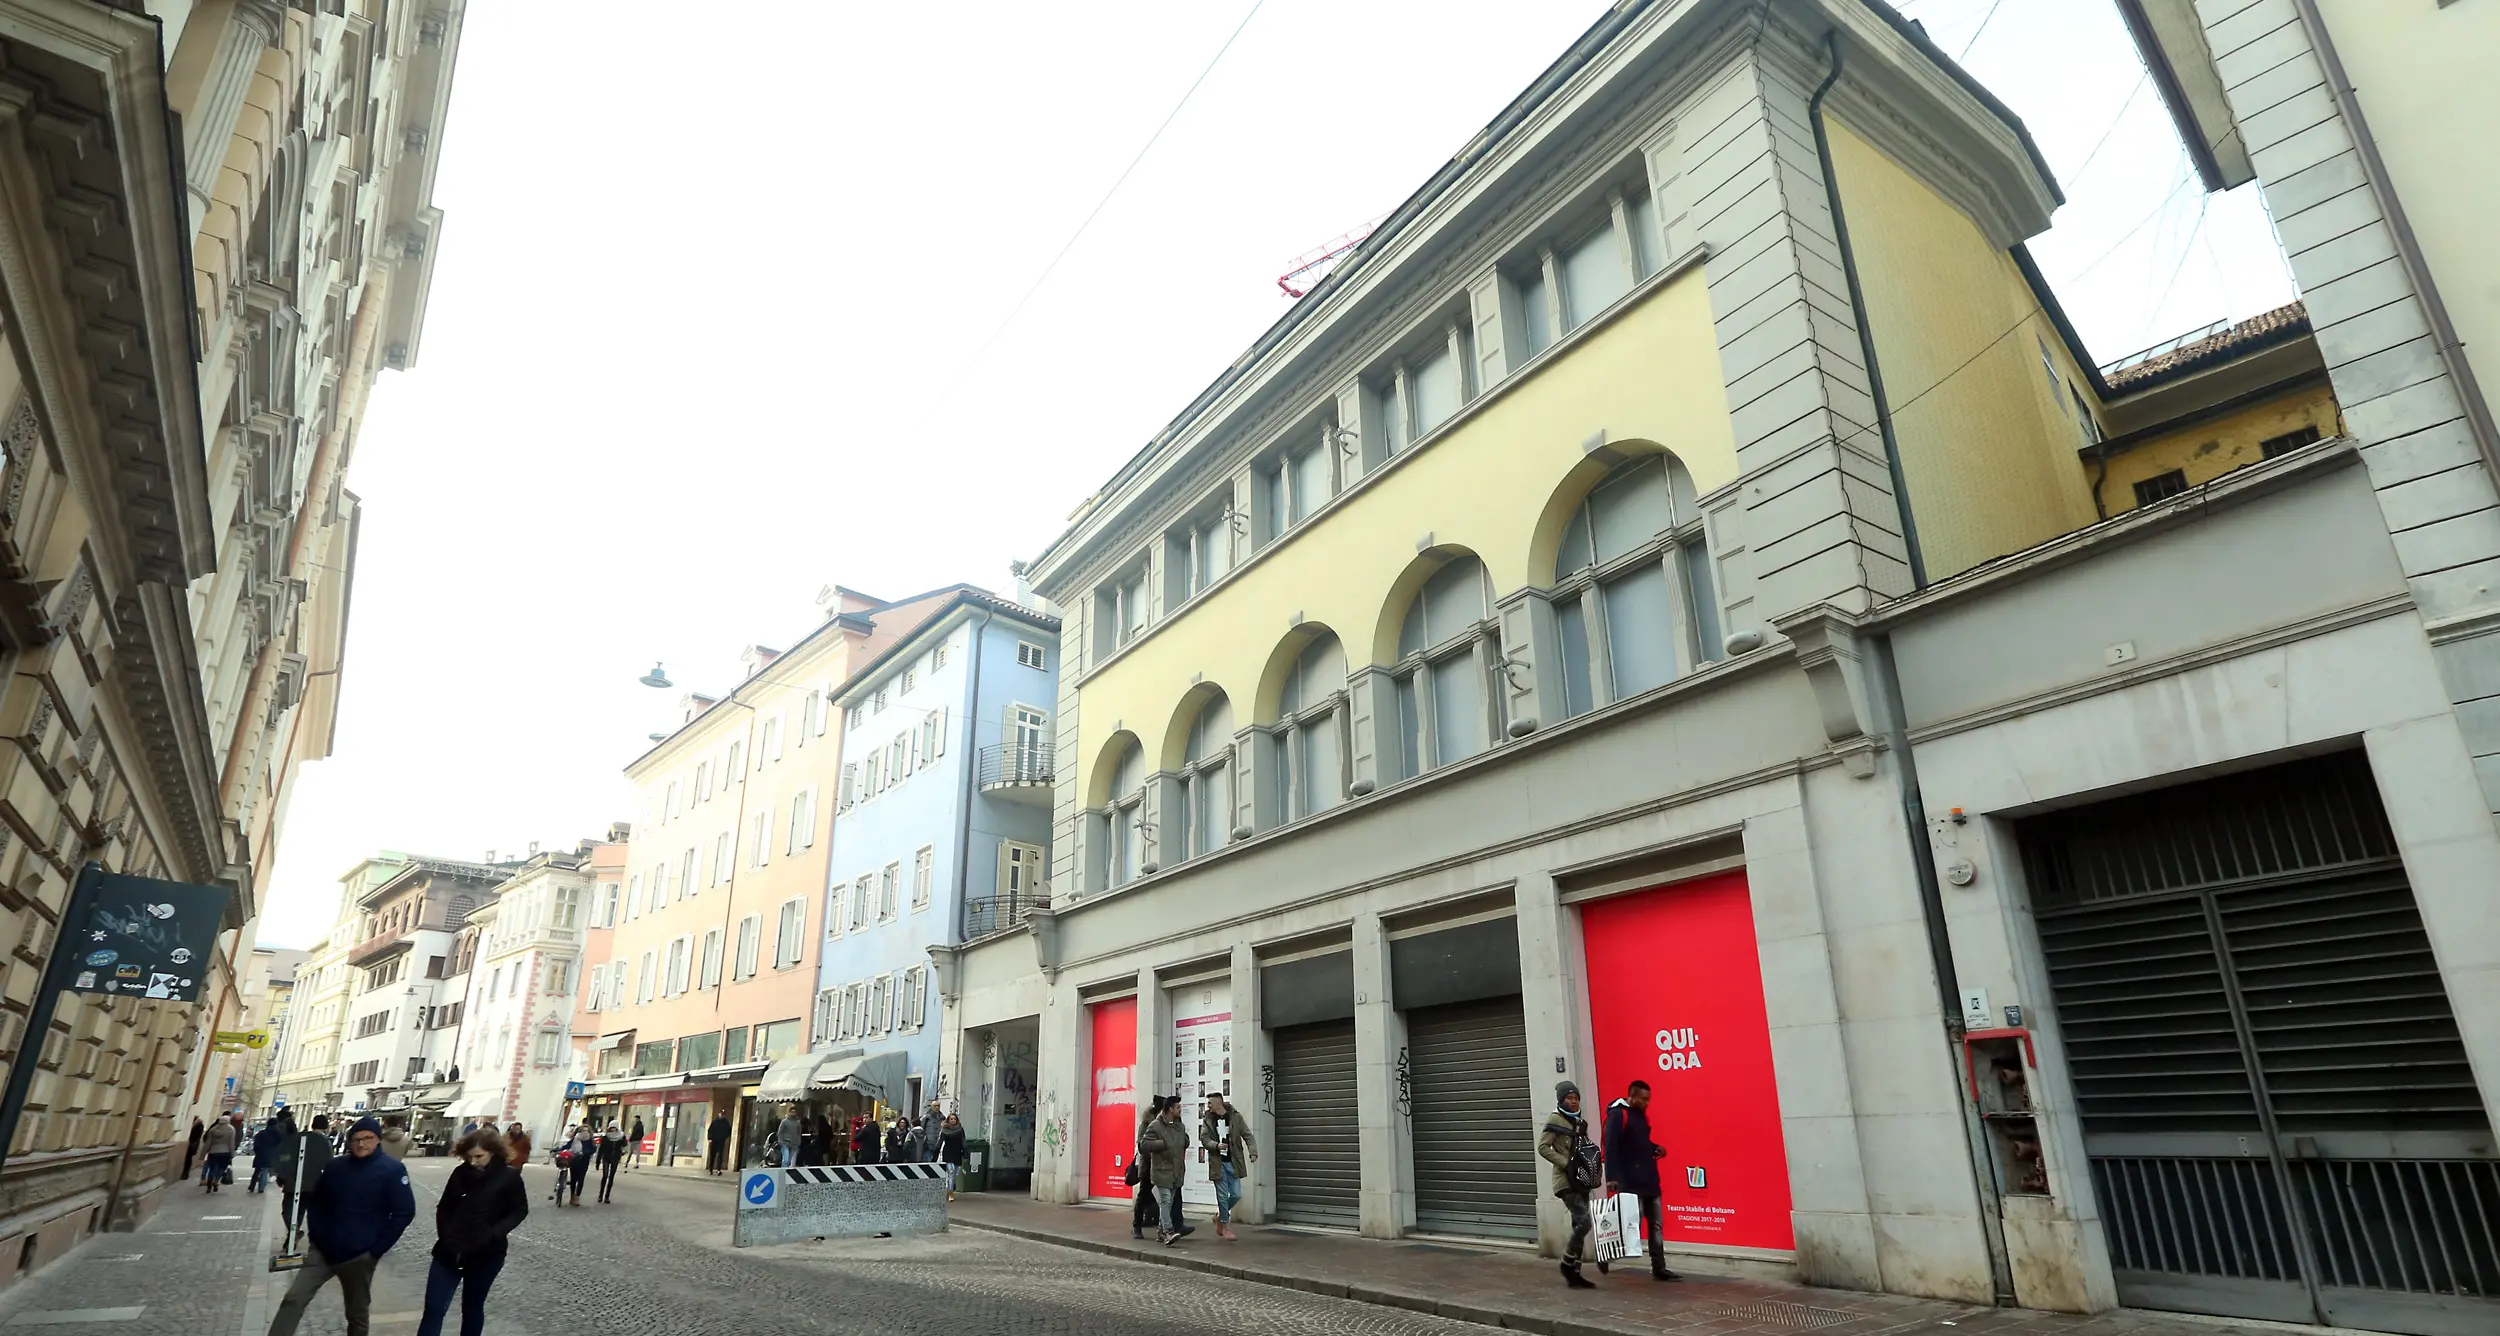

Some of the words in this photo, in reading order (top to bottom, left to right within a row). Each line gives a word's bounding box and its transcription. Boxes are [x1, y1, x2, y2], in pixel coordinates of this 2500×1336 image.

[247, 1034, 265, 1043] PT
[1658, 1051, 1702, 1071] ORA
[1667, 1204, 1685, 1212] Teatro
[1685, 1205, 1705, 1213] Stabile
[1712, 1207, 1736, 1215] Bolzano
